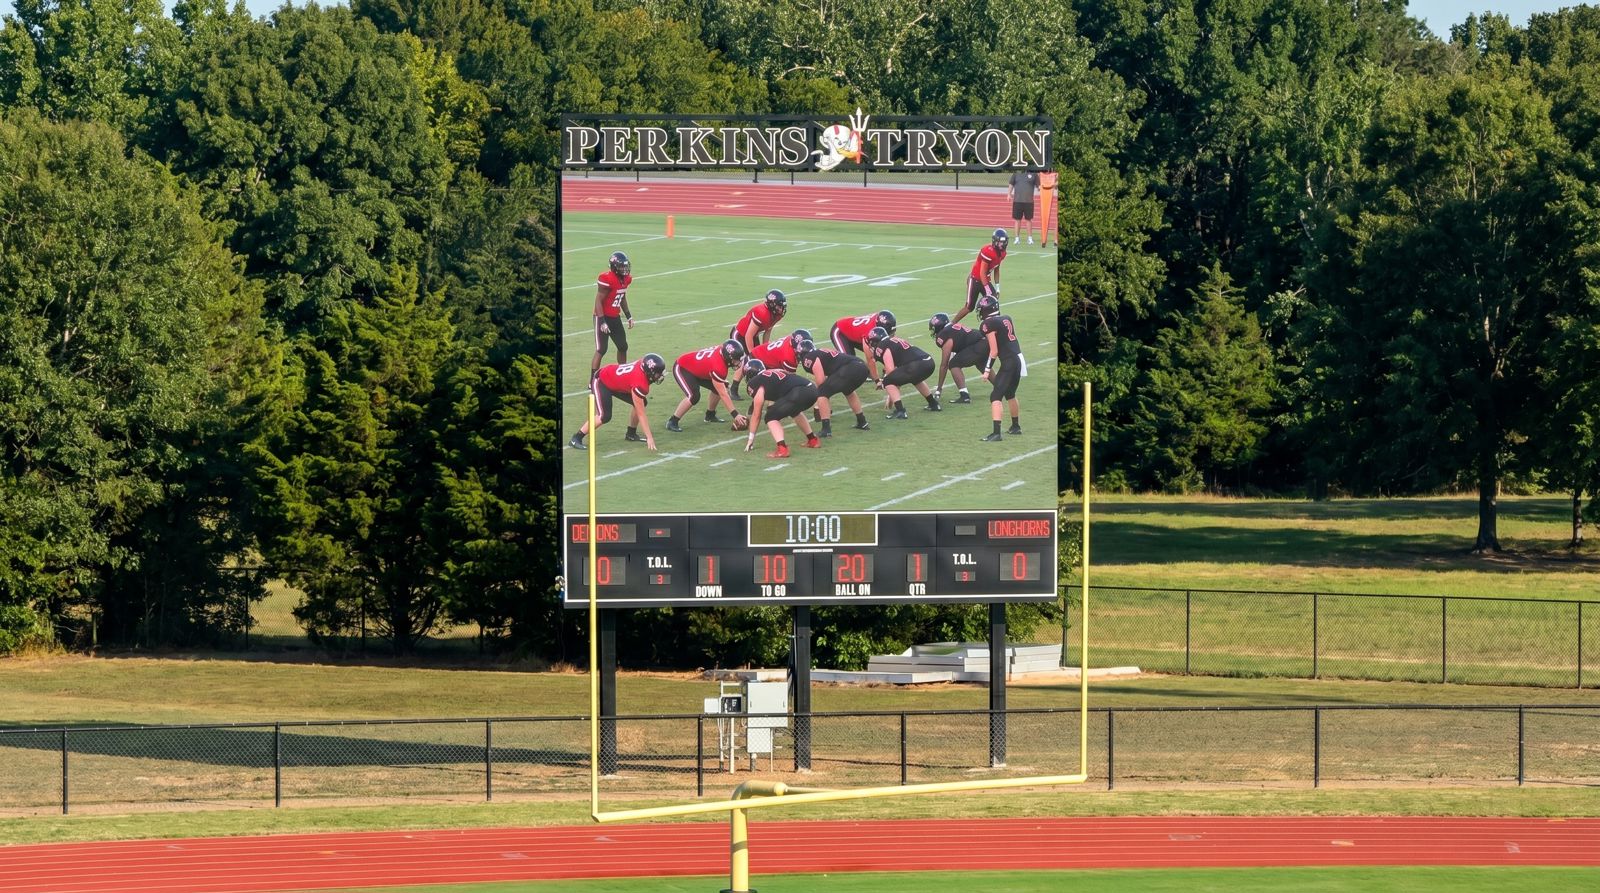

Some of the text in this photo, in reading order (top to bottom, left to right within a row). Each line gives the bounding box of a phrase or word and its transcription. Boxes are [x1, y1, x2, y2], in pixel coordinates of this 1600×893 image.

[565, 126, 809, 165] PERKINS
[867, 128, 1050, 167] TRYON
[1002, 319, 1016, 341] 2
[785, 515, 841, 543] 10:00
[988, 520, 1050, 538] LONGHORNS
[647, 556, 672, 568] T.O.L.
[706, 555, 716, 584] 1
[762, 554, 787, 584] 10
[837, 553, 865, 583] 20
[912, 553, 922, 581] 1
[952, 553, 977, 565] T.O.L.
[1013, 552, 1027, 581] 0
[597, 556, 611, 585] 0
[656, 575, 664, 584] 3
[961, 571, 969, 581] 3
[695, 586, 723, 598] DOWN
[760, 585, 786, 597] TO GO
[835, 583, 871, 596] BALL ON
[909, 583, 926, 596] QTR
